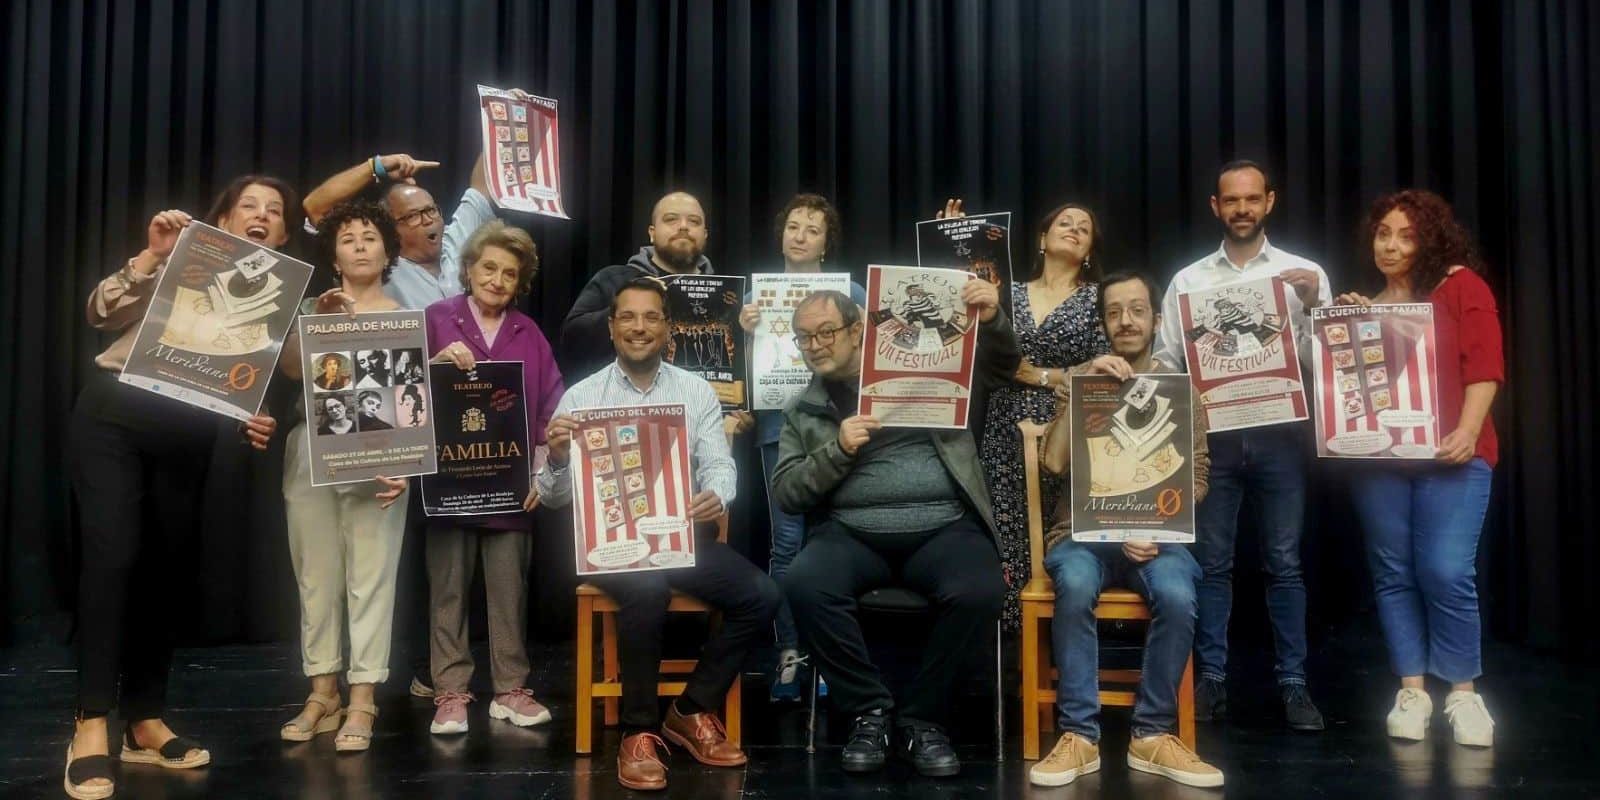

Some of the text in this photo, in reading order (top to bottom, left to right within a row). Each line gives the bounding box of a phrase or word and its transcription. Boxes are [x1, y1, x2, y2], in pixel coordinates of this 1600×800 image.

[1313, 305, 1430, 320] EL CUENTO DEL PAYASO
[306, 319, 420, 334] PALABRA DE MUJER
[895, 343, 959, 369] FESTIVAL
[1219, 343, 1280, 372] FESTIVAL
[588, 409, 625, 421] CUENTO
[627, 408, 646, 417] DEL
[648, 407, 683, 416] PAYASO
